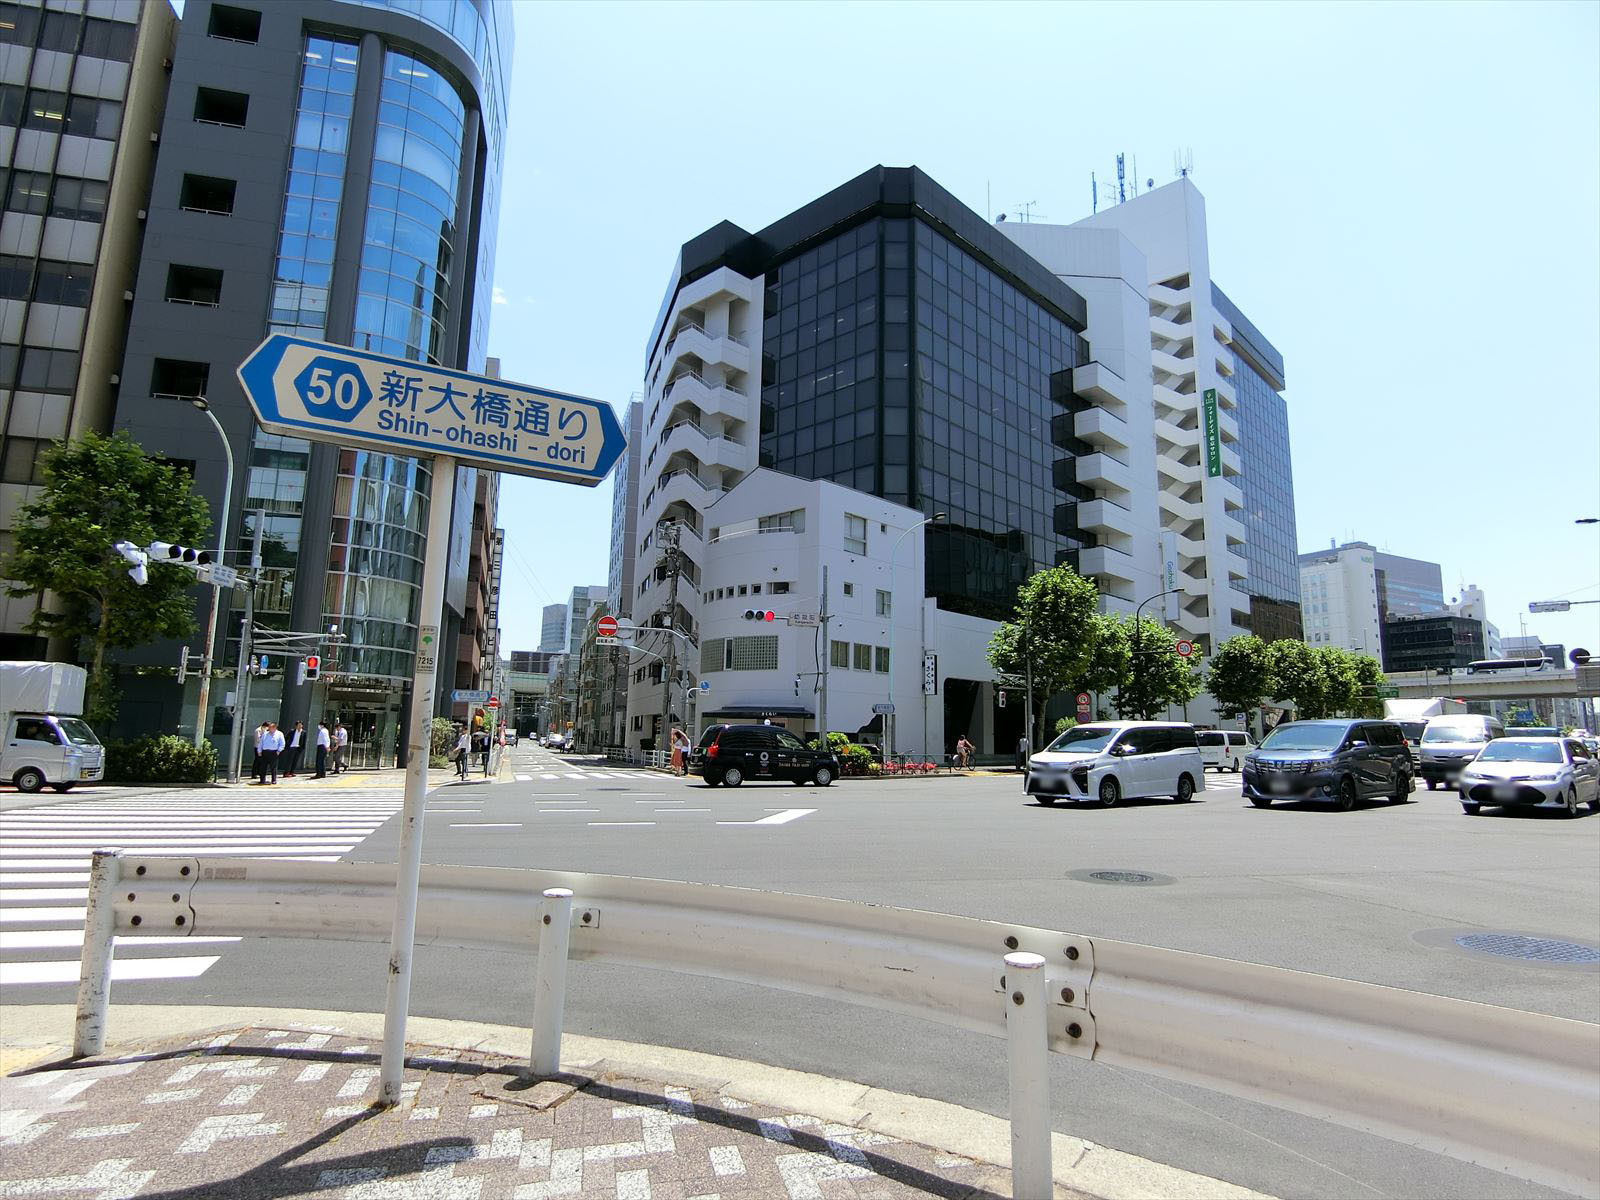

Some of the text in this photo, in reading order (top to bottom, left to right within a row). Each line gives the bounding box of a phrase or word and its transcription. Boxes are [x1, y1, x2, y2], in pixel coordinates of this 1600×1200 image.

[306, 368, 360, 411] 50
[378, 369, 588, 441] 新大橋通り
[1180, 645, 1190, 653] 50
[1236, 713, 1244, 721] P
